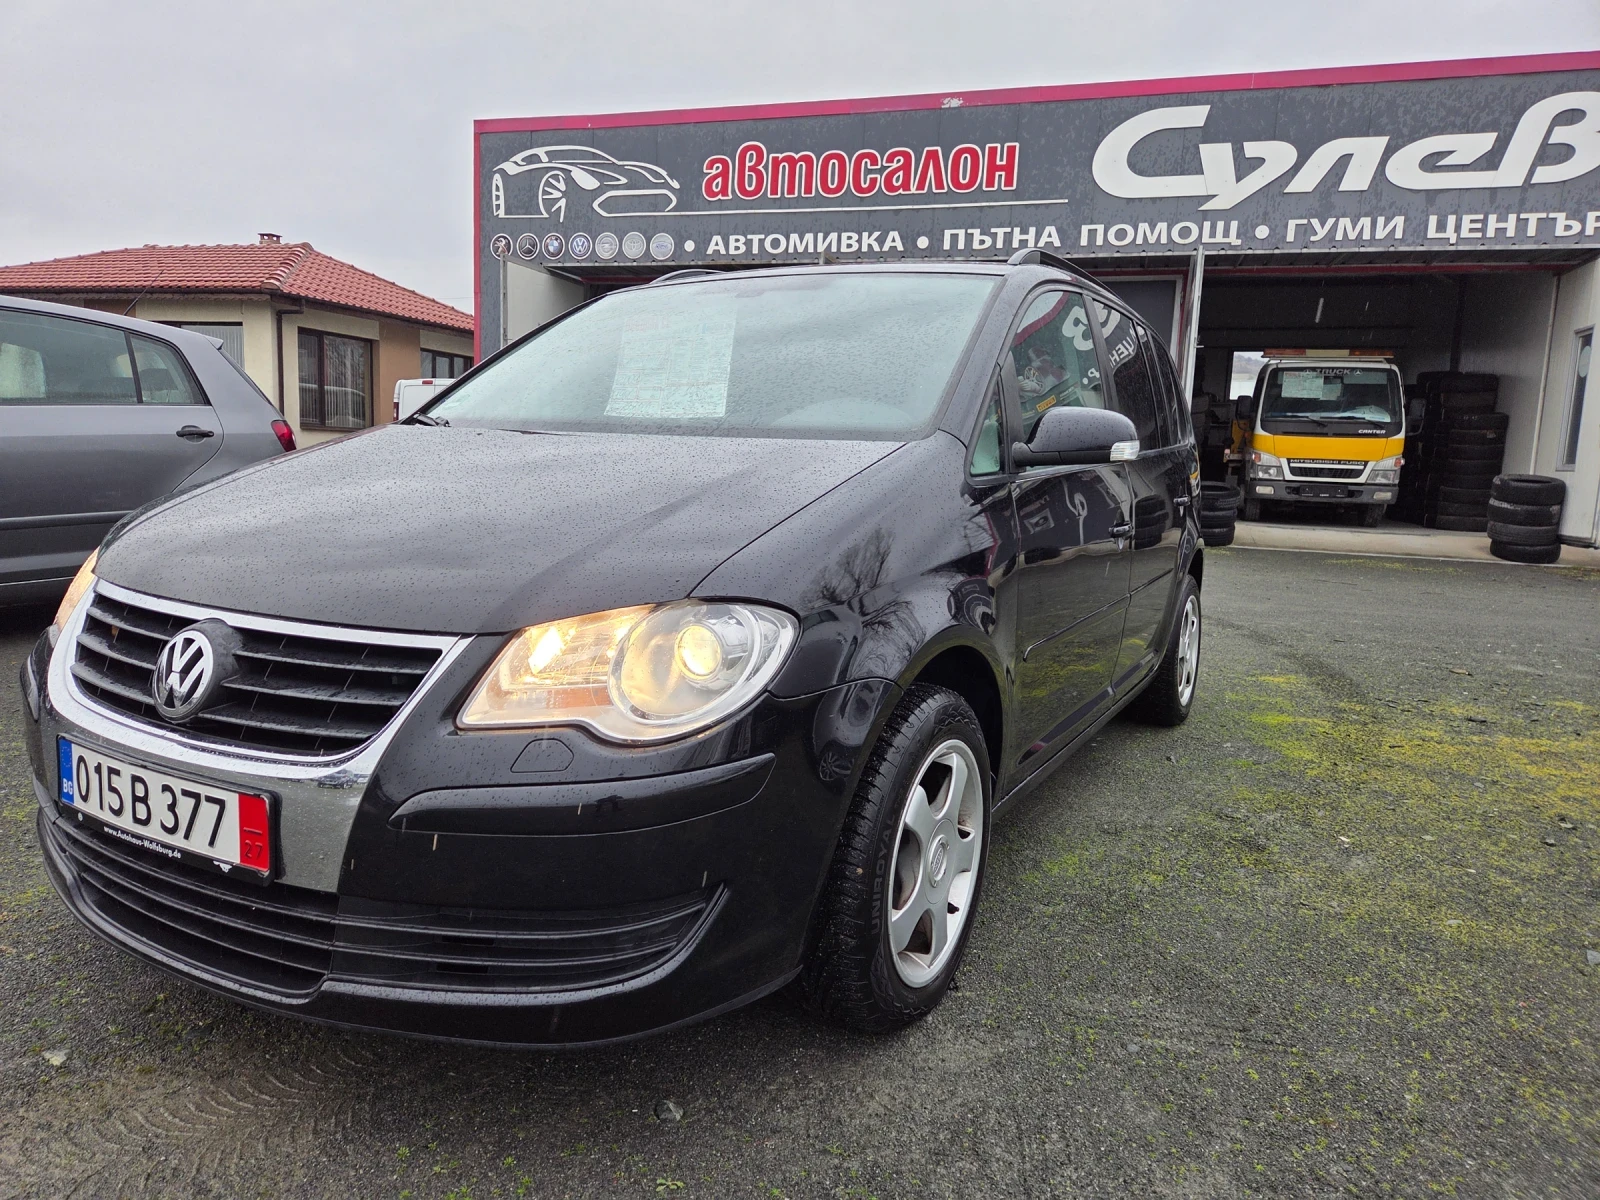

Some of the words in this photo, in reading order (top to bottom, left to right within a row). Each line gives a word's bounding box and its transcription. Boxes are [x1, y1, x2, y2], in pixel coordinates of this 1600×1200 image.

[702, 141, 1020, 202] автосалон
[706, 231, 904, 255] АВТОМИВКА
[943, 225, 1062, 250] ПЪТНА
[1080, 220, 1241, 247] ПОМОЩ
[1286, 215, 1405, 243] ГУМИ
[62, 778, 73, 795] BG
[131, 773, 152, 827] B
[160, 783, 226, 848] 377
[103, 826, 182, 859] www.Autohaus-Wolfsburg.de
[871, 814, 895, 934] UNIROYAL
